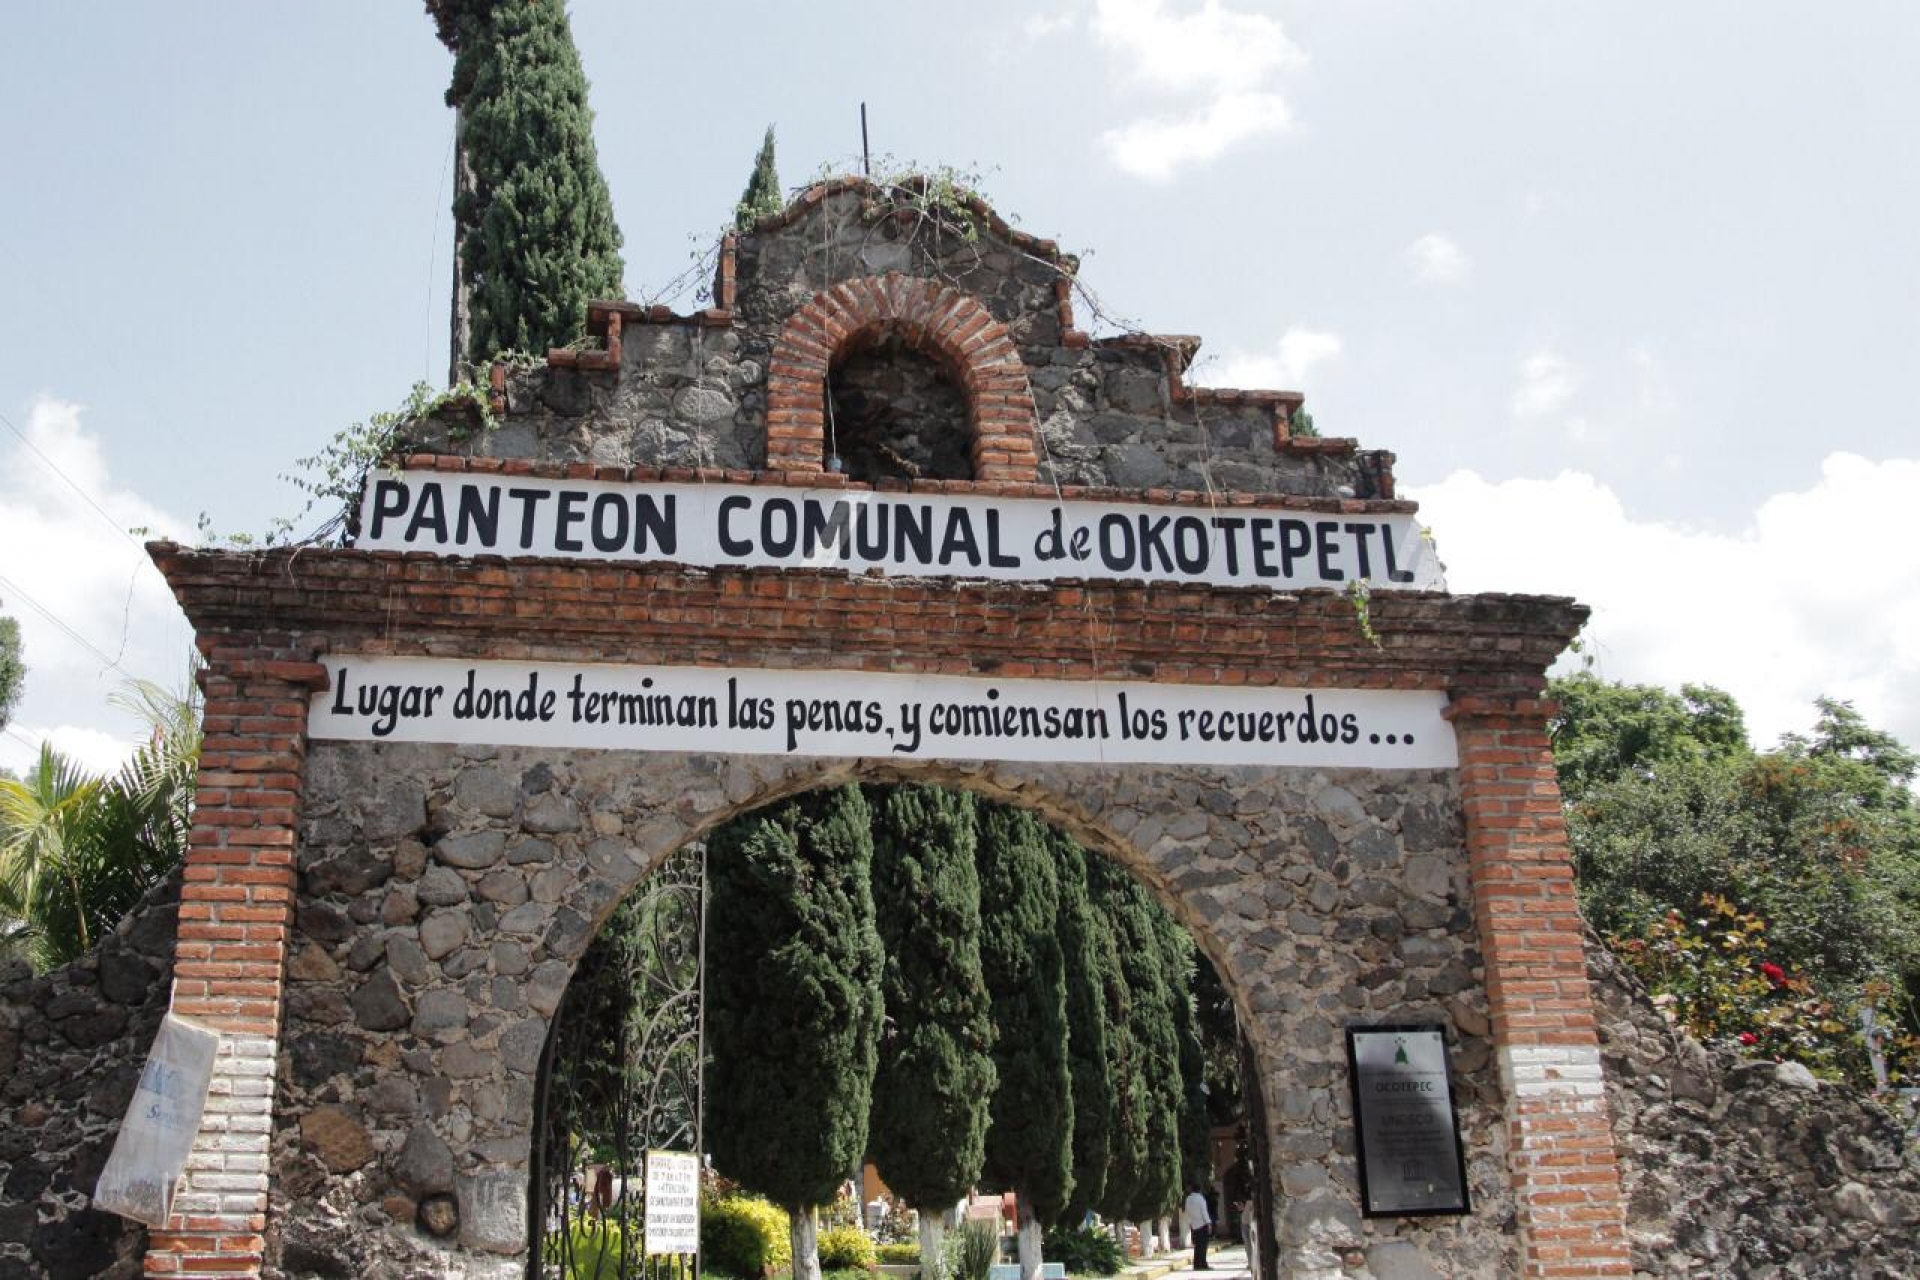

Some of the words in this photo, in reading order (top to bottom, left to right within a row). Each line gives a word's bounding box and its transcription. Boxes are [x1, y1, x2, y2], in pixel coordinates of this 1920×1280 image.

[369, 479, 677, 556] PANTEON
[717, 495, 1021, 568] COMUNAL
[1034, 508, 1092, 562] de
[1098, 513, 1414, 583] OKOTEPETL
[331, 667, 445, 737] Lugar
[453, 668, 556, 722] donde
[566, 673, 718, 728] terminan
[728, 678, 775, 730] las
[929, 688, 1110, 739] comiensan
[1117, 691, 1168, 741] los
[1375, 1081, 1433, 1093] OCOTEPEC
